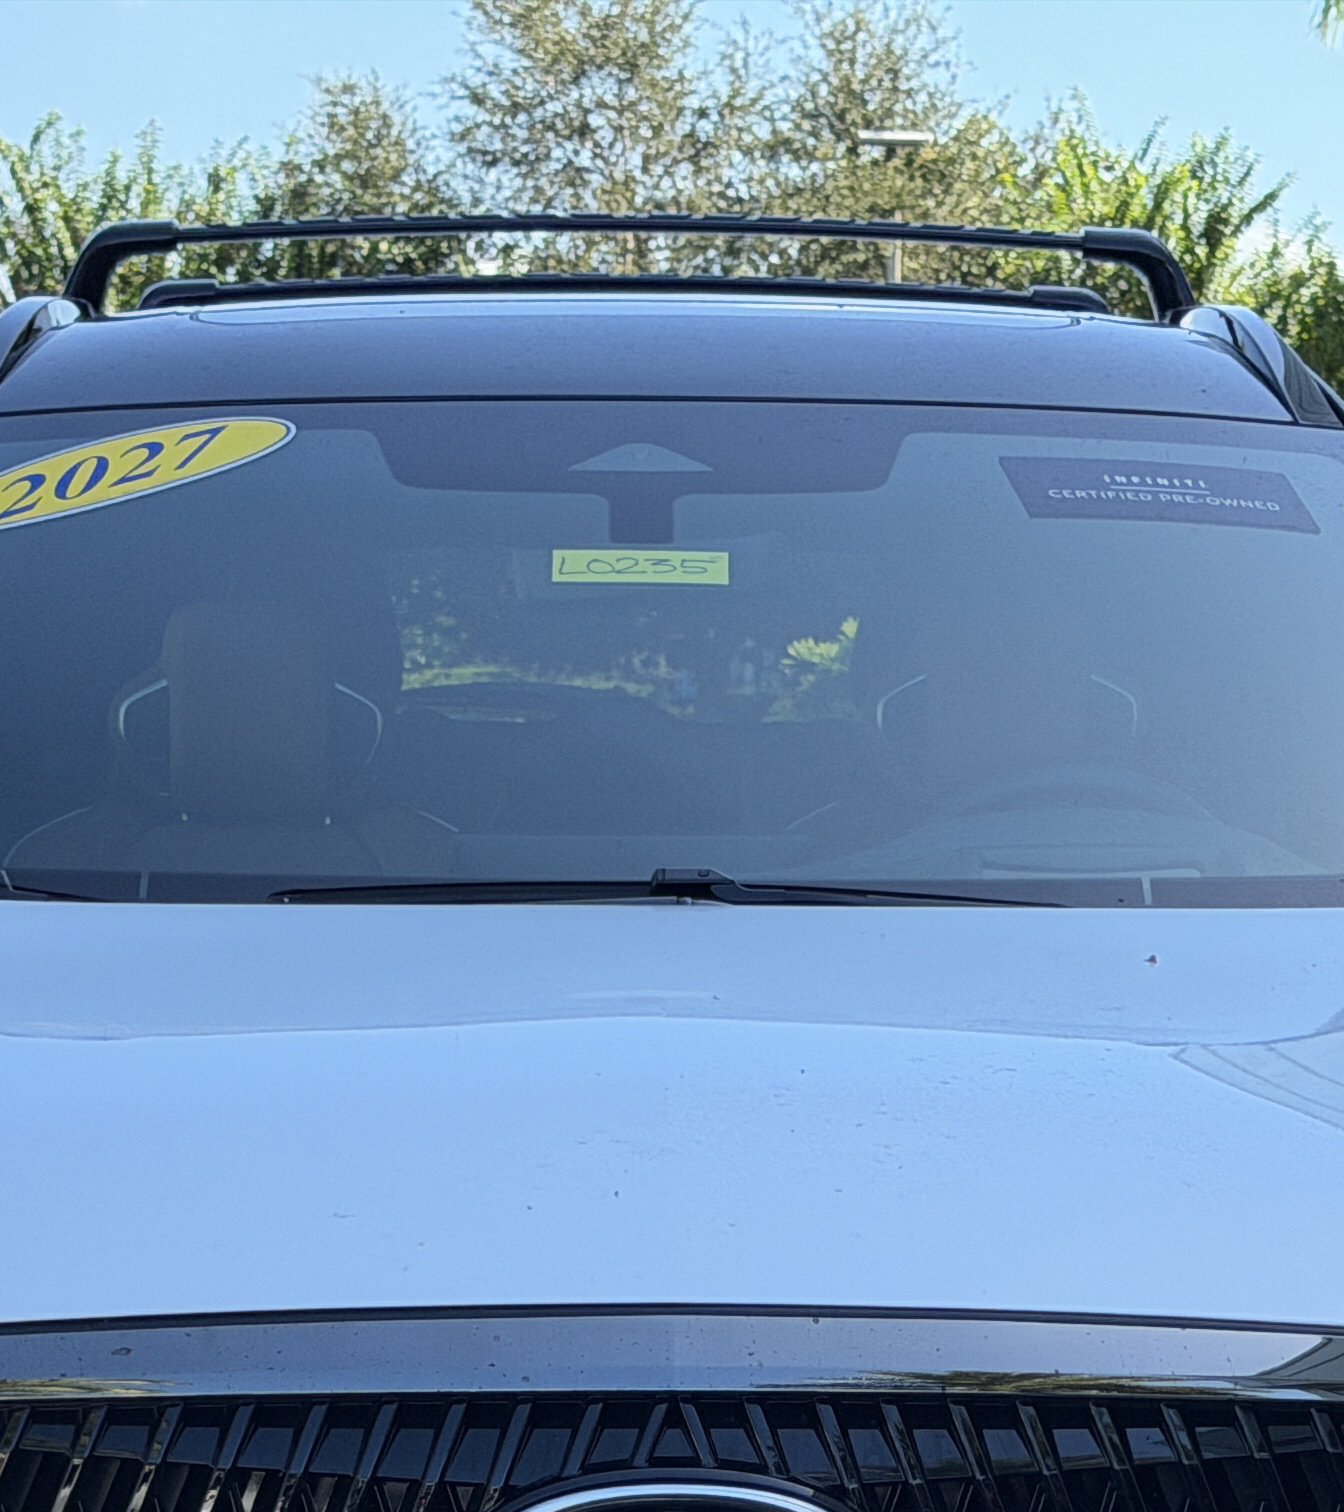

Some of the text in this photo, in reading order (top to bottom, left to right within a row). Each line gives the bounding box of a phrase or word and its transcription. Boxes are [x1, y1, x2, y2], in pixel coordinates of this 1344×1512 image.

[1103, 473, 1209, 489] INFINITI
[1047, 488, 1281, 512] CERTIFIED PRE-OWNED
